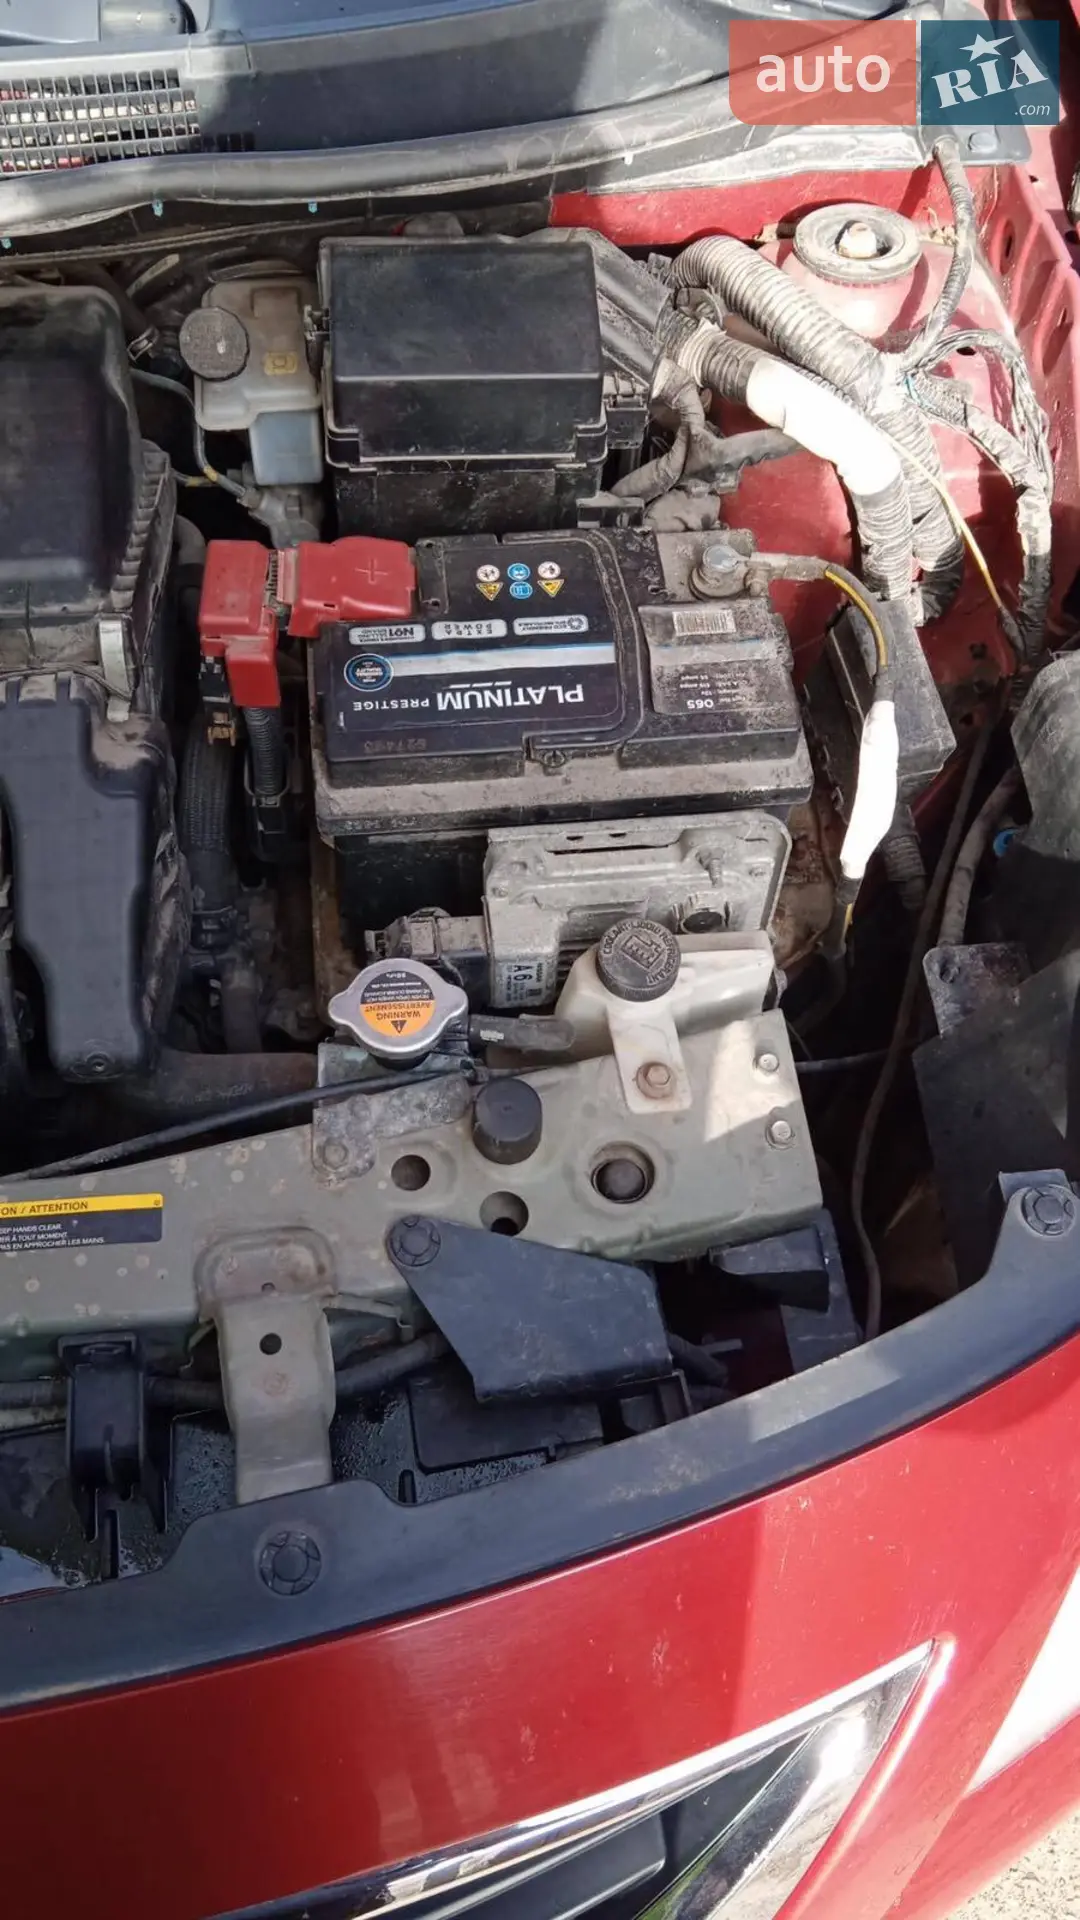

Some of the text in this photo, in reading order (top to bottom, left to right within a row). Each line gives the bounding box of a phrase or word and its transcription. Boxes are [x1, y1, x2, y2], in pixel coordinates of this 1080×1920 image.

[444, 622, 492, 631] POWER
[353, 683, 585, 711] PLATINUM PRESTIGE
[686, 698, 714, 709] 065
[365, 1002, 430, 1012] AVERTISSEMENT
[376, 1010, 421, 1020] WARNING
[29, 1202, 88, 1214] ATTENTION
